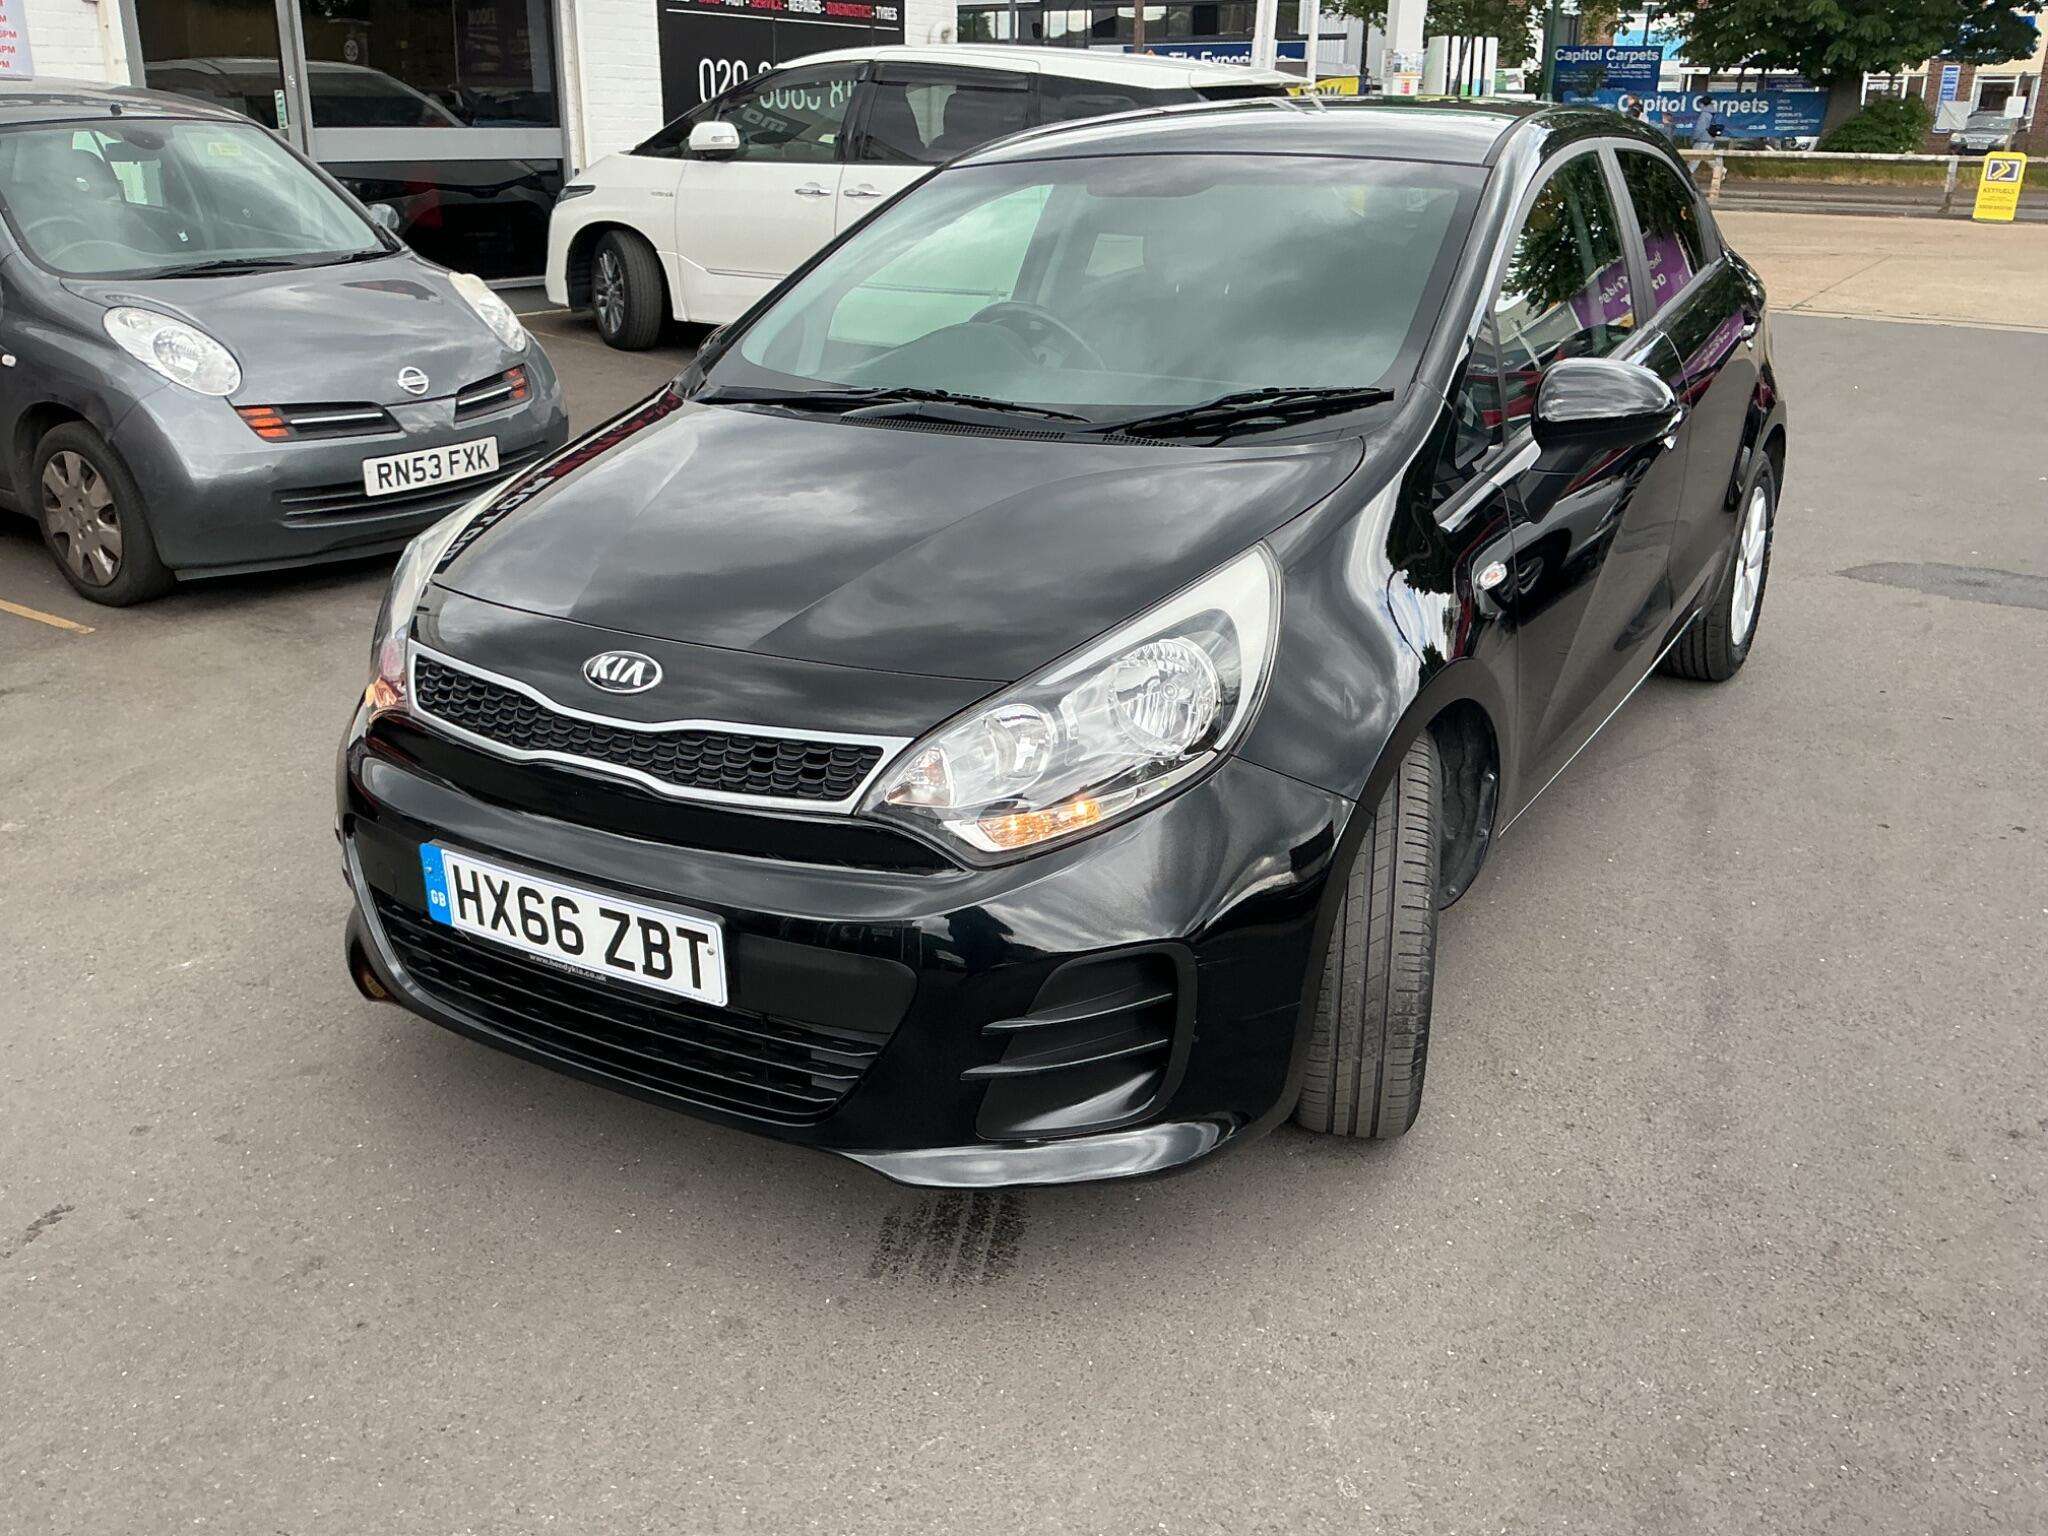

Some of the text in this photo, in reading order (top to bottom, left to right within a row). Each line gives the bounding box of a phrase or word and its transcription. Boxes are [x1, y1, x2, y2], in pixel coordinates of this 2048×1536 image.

[1554, 48, 1659, 63] Capitol Carpets
[1617, 94, 1687, 113] Cpitol
[376, 443, 490, 490] RN53 FXK
[590, 655, 645, 687] KIA
[430, 889, 446, 907] GB
[452, 863, 709, 990] HX66 ZBT
